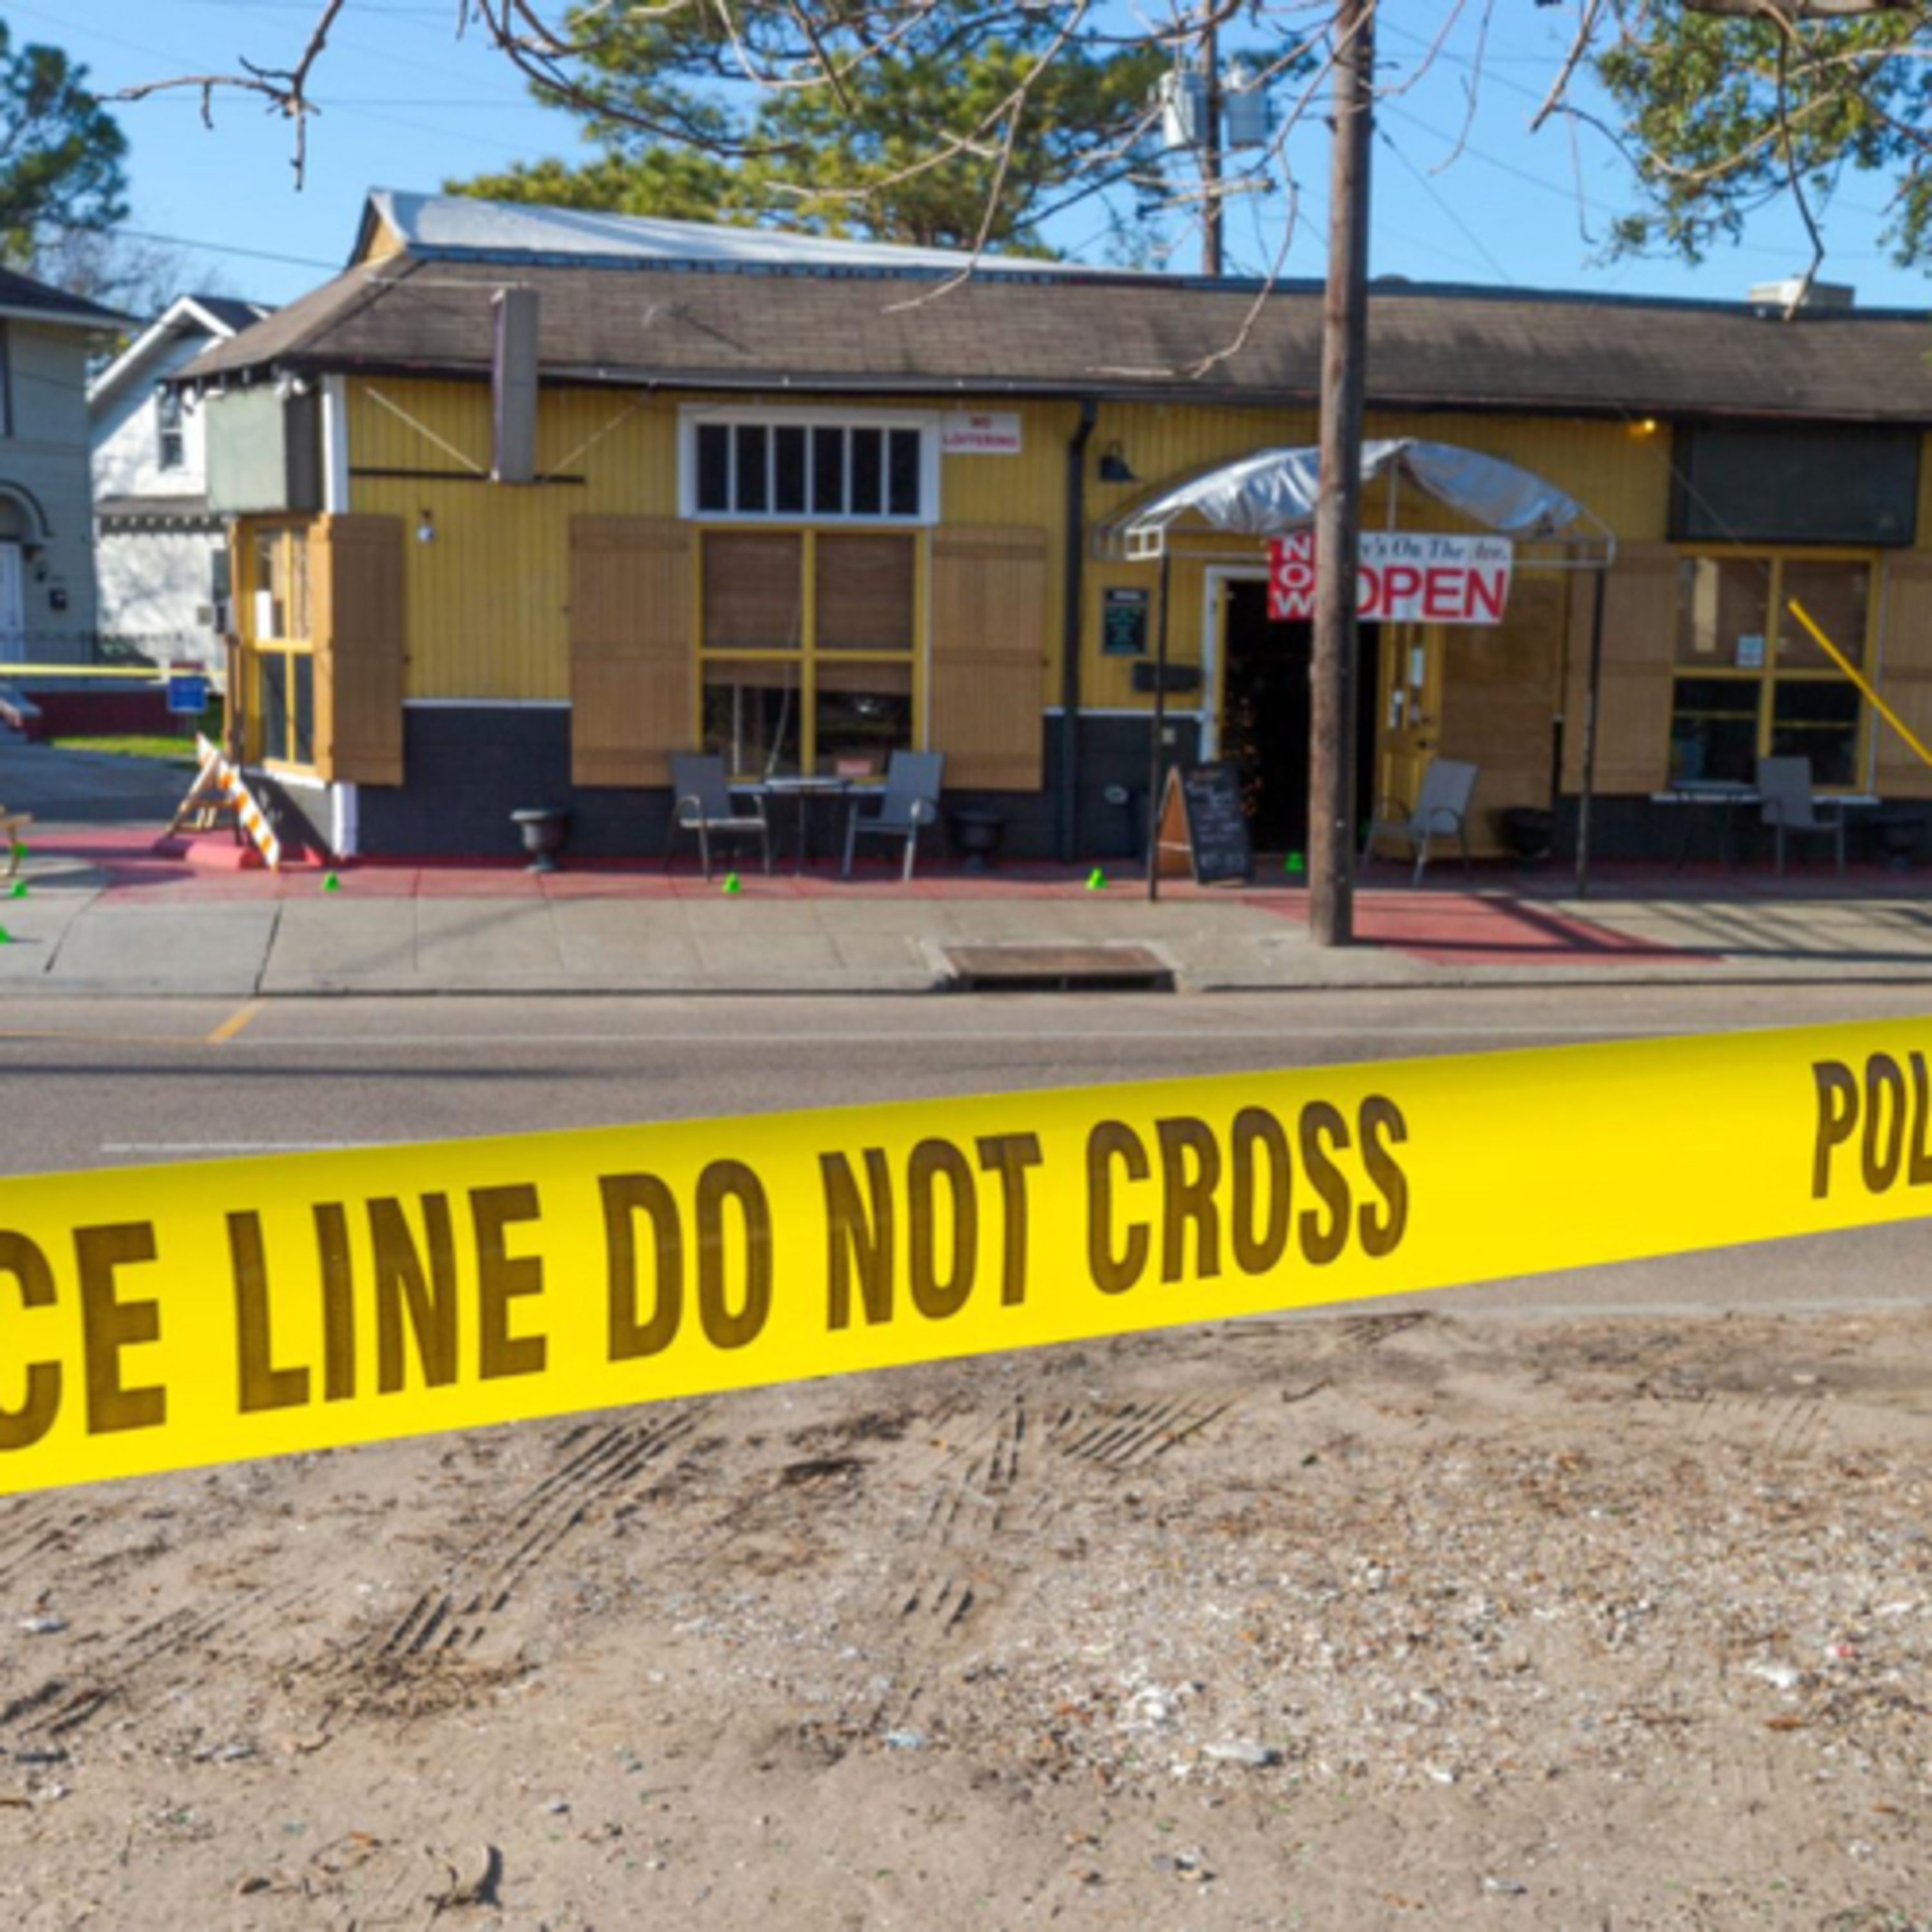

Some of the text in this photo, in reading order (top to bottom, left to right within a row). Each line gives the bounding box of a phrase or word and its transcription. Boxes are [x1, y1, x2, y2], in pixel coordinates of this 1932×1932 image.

[971, 416, 992, 428] NO
[943, 431, 1018, 448] LOITERING
[1428, 536, 1464, 558] The
[1275, 533, 1316, 616] NOW
[225, 1182, 547, 1414] LINE
[598, 1158, 773, 1363] DO
[818, 1132, 1044, 1332] NOT
[1085, 1094, 1410, 1295] CROSS
[1810, 1050, 1932, 1200] POL
